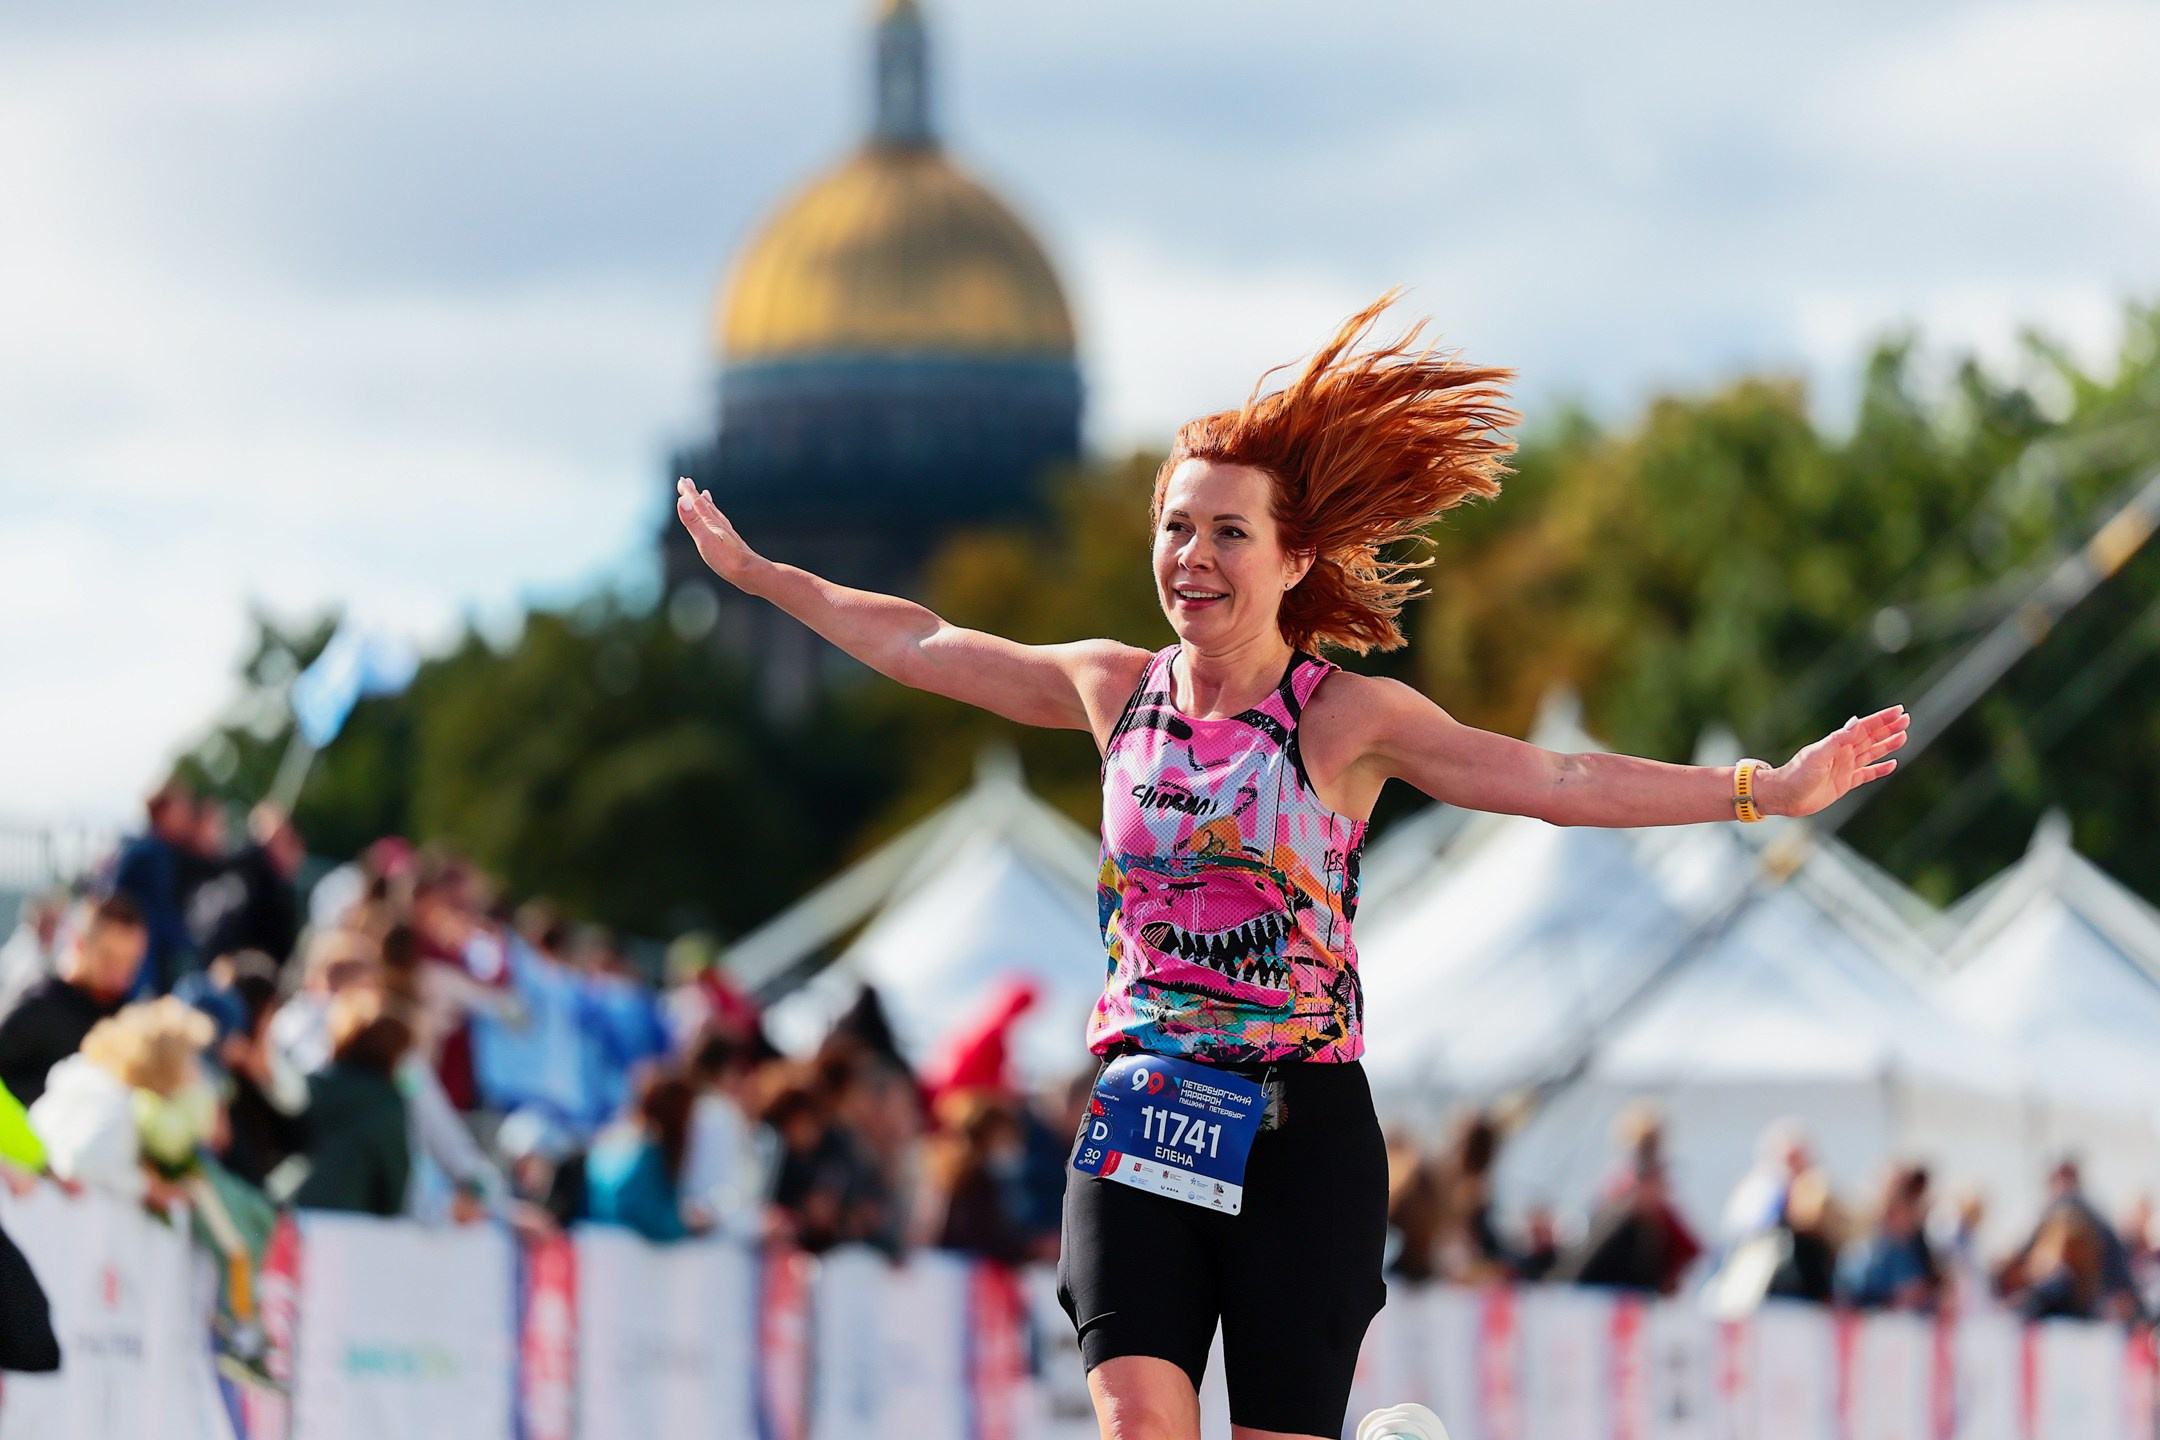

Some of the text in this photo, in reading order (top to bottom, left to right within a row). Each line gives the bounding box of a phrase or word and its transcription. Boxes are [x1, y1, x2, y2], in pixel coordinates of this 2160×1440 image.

[1131, 1068, 1164, 1095] 99
[1182, 1079, 1252, 1106] ПЕТЕРБУРГСКИЙ
[1179, 1097, 1246, 1120] ПУШКИН ПЕТЕРБУРГ
[1180, 1089, 1222, 1106] МАРАФОН
[1091, 1121, 1108, 1140] D
[1141, 1105, 1222, 1159] 11741
[1085, 1148, 1101, 1160] 30
[1155, 1146, 1194, 1167] ЕЛЕНА
